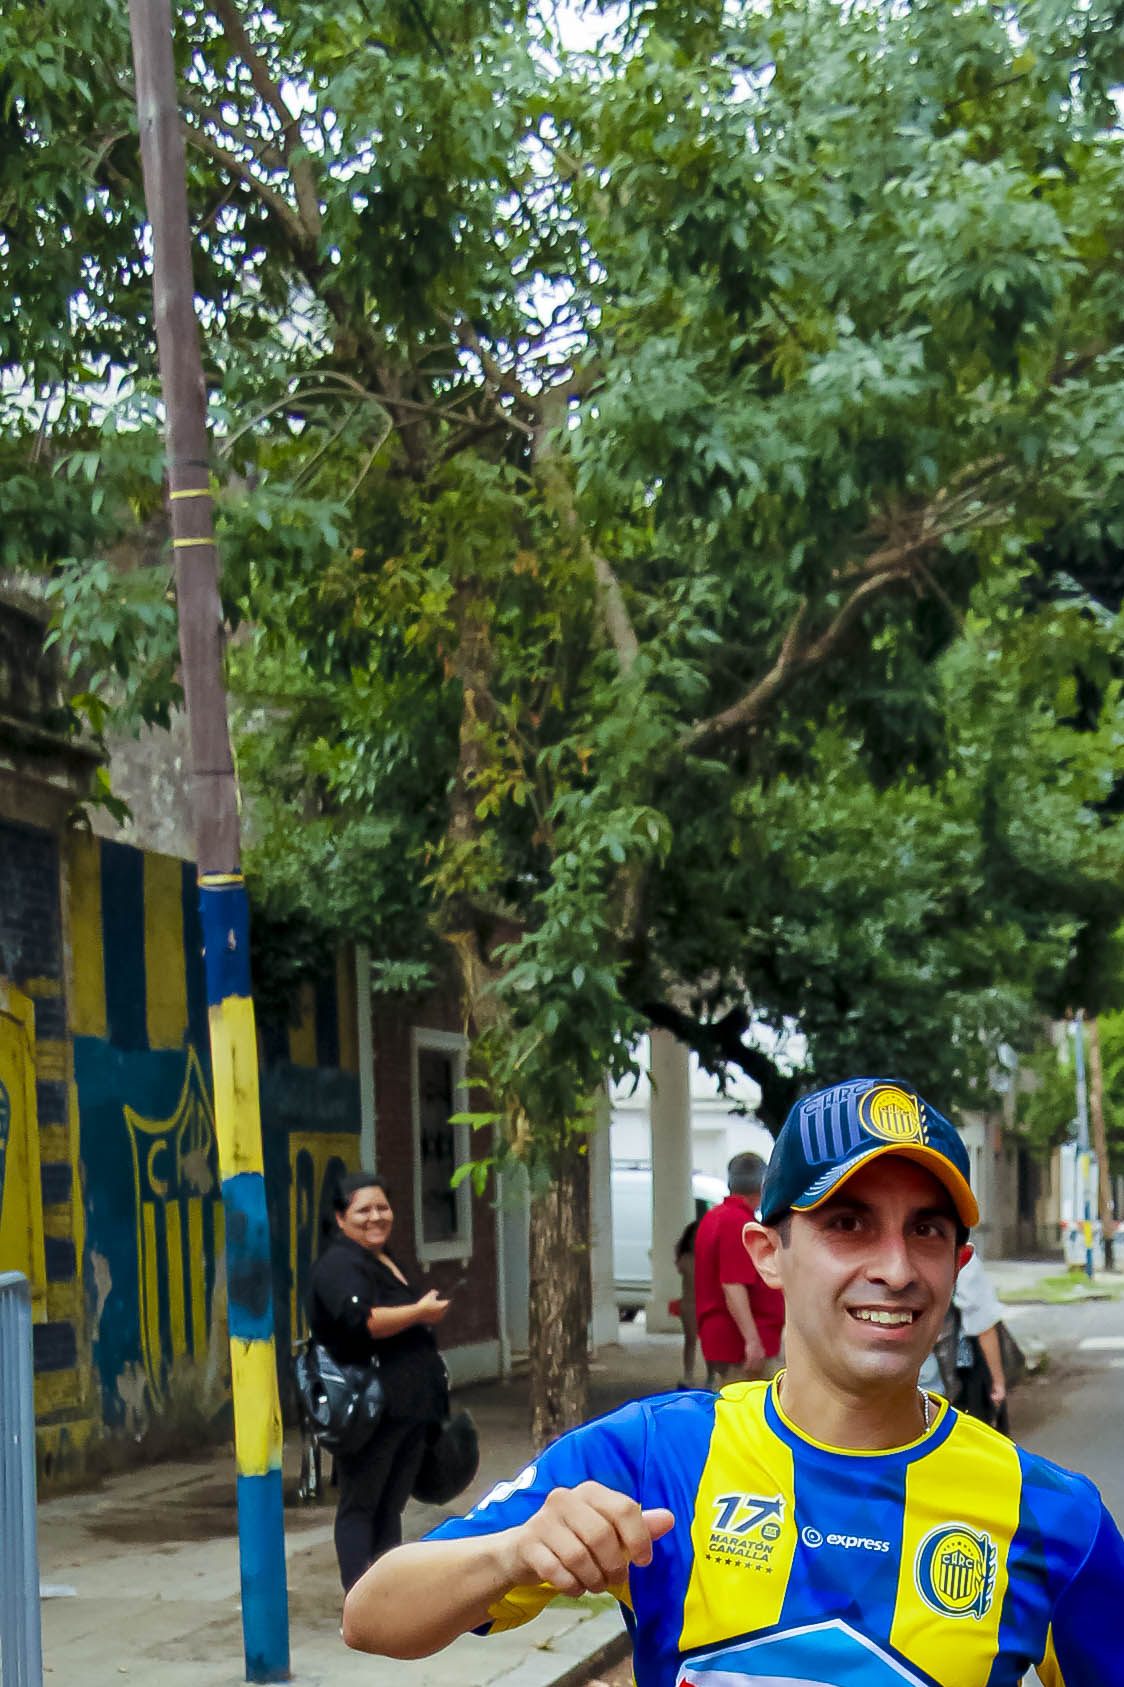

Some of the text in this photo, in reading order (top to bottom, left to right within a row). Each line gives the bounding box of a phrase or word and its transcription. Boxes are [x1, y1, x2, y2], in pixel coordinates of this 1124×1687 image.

[710, 1533, 775, 1554] MARATÓN
[826, 1532, 891, 1553] express
[709, 1543, 769, 1563] CANALLA
[942, 1552, 974, 1568] CARC
